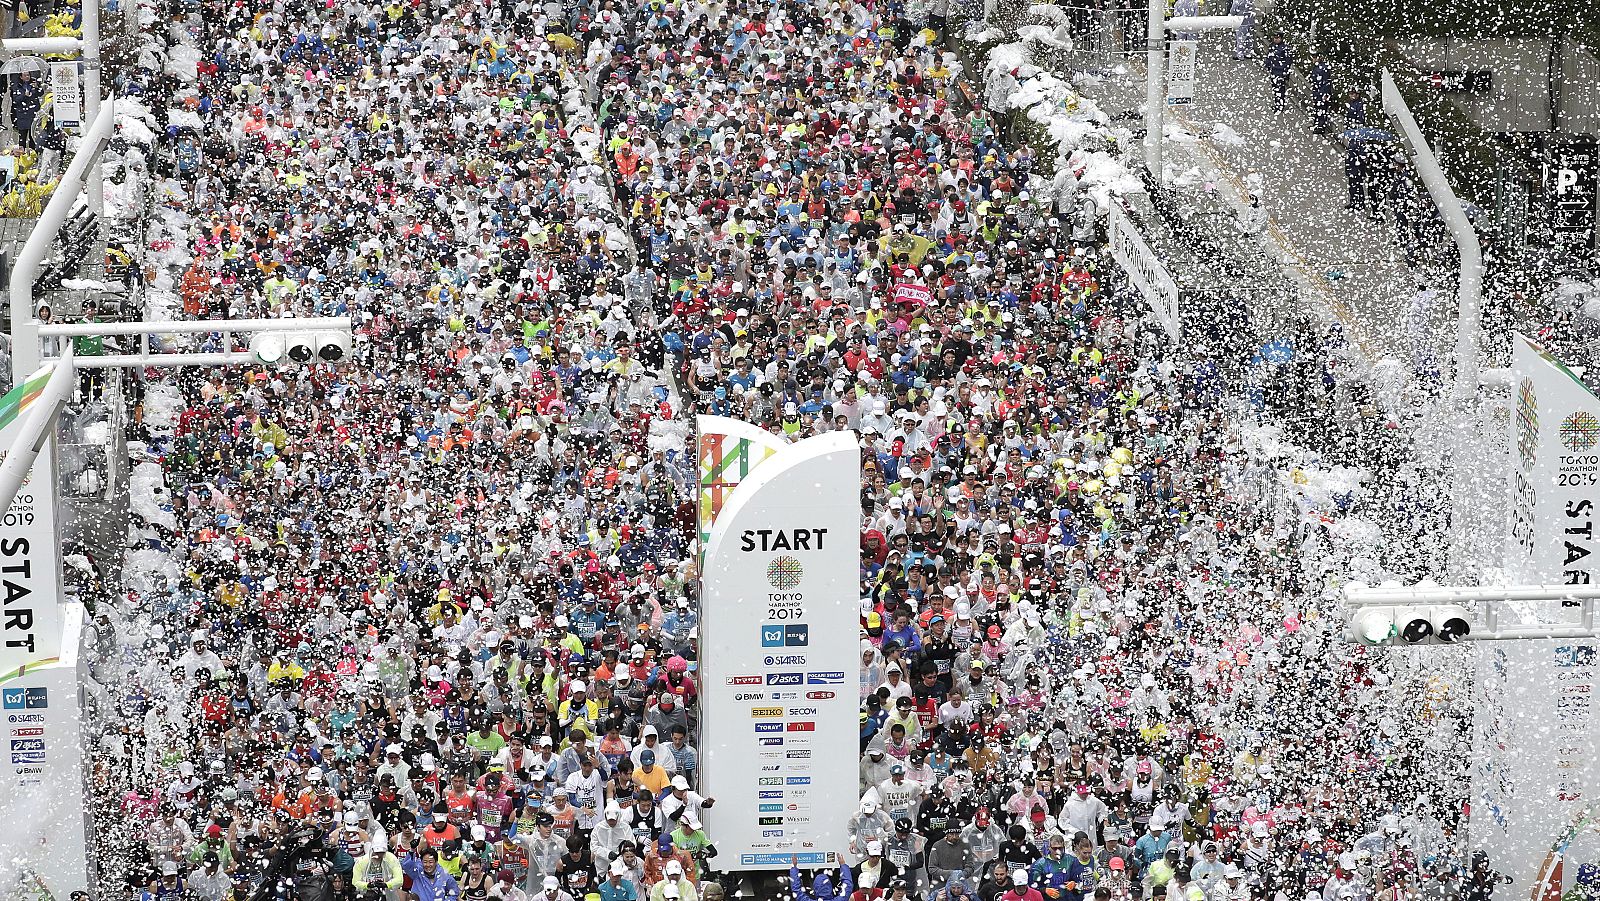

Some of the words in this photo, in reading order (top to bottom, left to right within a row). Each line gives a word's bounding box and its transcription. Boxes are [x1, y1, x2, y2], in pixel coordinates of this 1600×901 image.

[1558, 169, 1577, 195] P
[1559, 455, 1599, 465] TOKYO
[1558, 473, 1597, 487] 2019
[741, 529, 828, 552] START
[1, 537, 35, 653] START
[768, 593, 803, 602] TOKYO
[768, 608, 803, 620] 2019
[752, 708, 782, 716] SEIKO
[789, 707, 817, 715] SECOM
